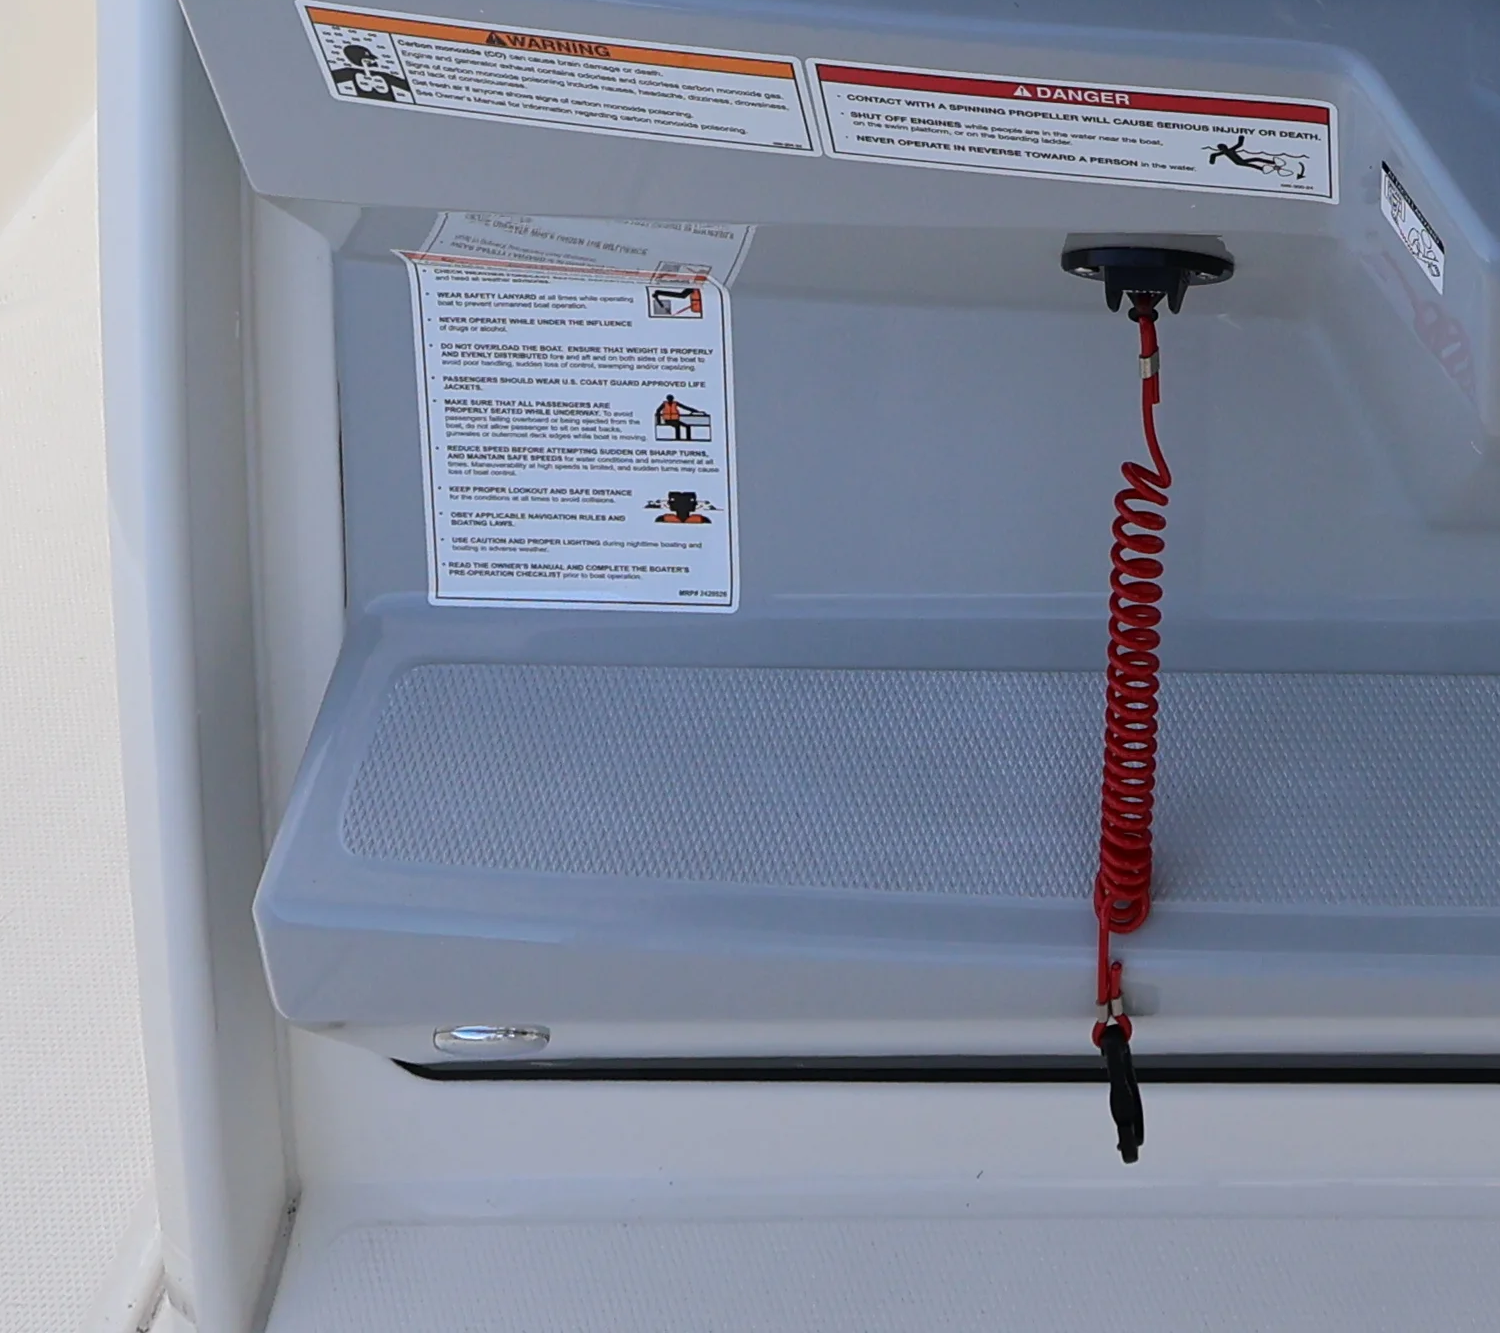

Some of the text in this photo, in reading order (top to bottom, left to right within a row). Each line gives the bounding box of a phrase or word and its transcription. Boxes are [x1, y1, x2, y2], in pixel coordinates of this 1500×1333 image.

[506, 33, 611, 58] WARNING
[1036, 85, 1132, 106] DANGER
[846, 93, 902, 105] CONTACT
[904, 99, 935, 109] WITH
[948, 103, 1006, 115] SPINNING
[1008, 109, 1079, 121] PROPELLER
[1081, 115, 1110, 124] WILL
[1112, 118, 1154, 127] CAUSE
[1156, 121, 1209, 132] SERIOUS
[1212, 125, 1255, 135] INJURY
[1258, 129, 1276, 137] OR
[850, 111, 882, 120] SHUT
[884, 114, 907, 123] OFF
[909, 117, 962, 128] ENGINES
[856, 134, 895, 145] NEVER
[897, 138, 951, 150] OPERATE
[968, 145, 1022, 157] REVERSE
[1024, 150, 1076, 161] TOWARD
[1089, 156, 1138, 167] PERSON
[436, 291, 537, 301] WEAR SAFETY LANYARD
